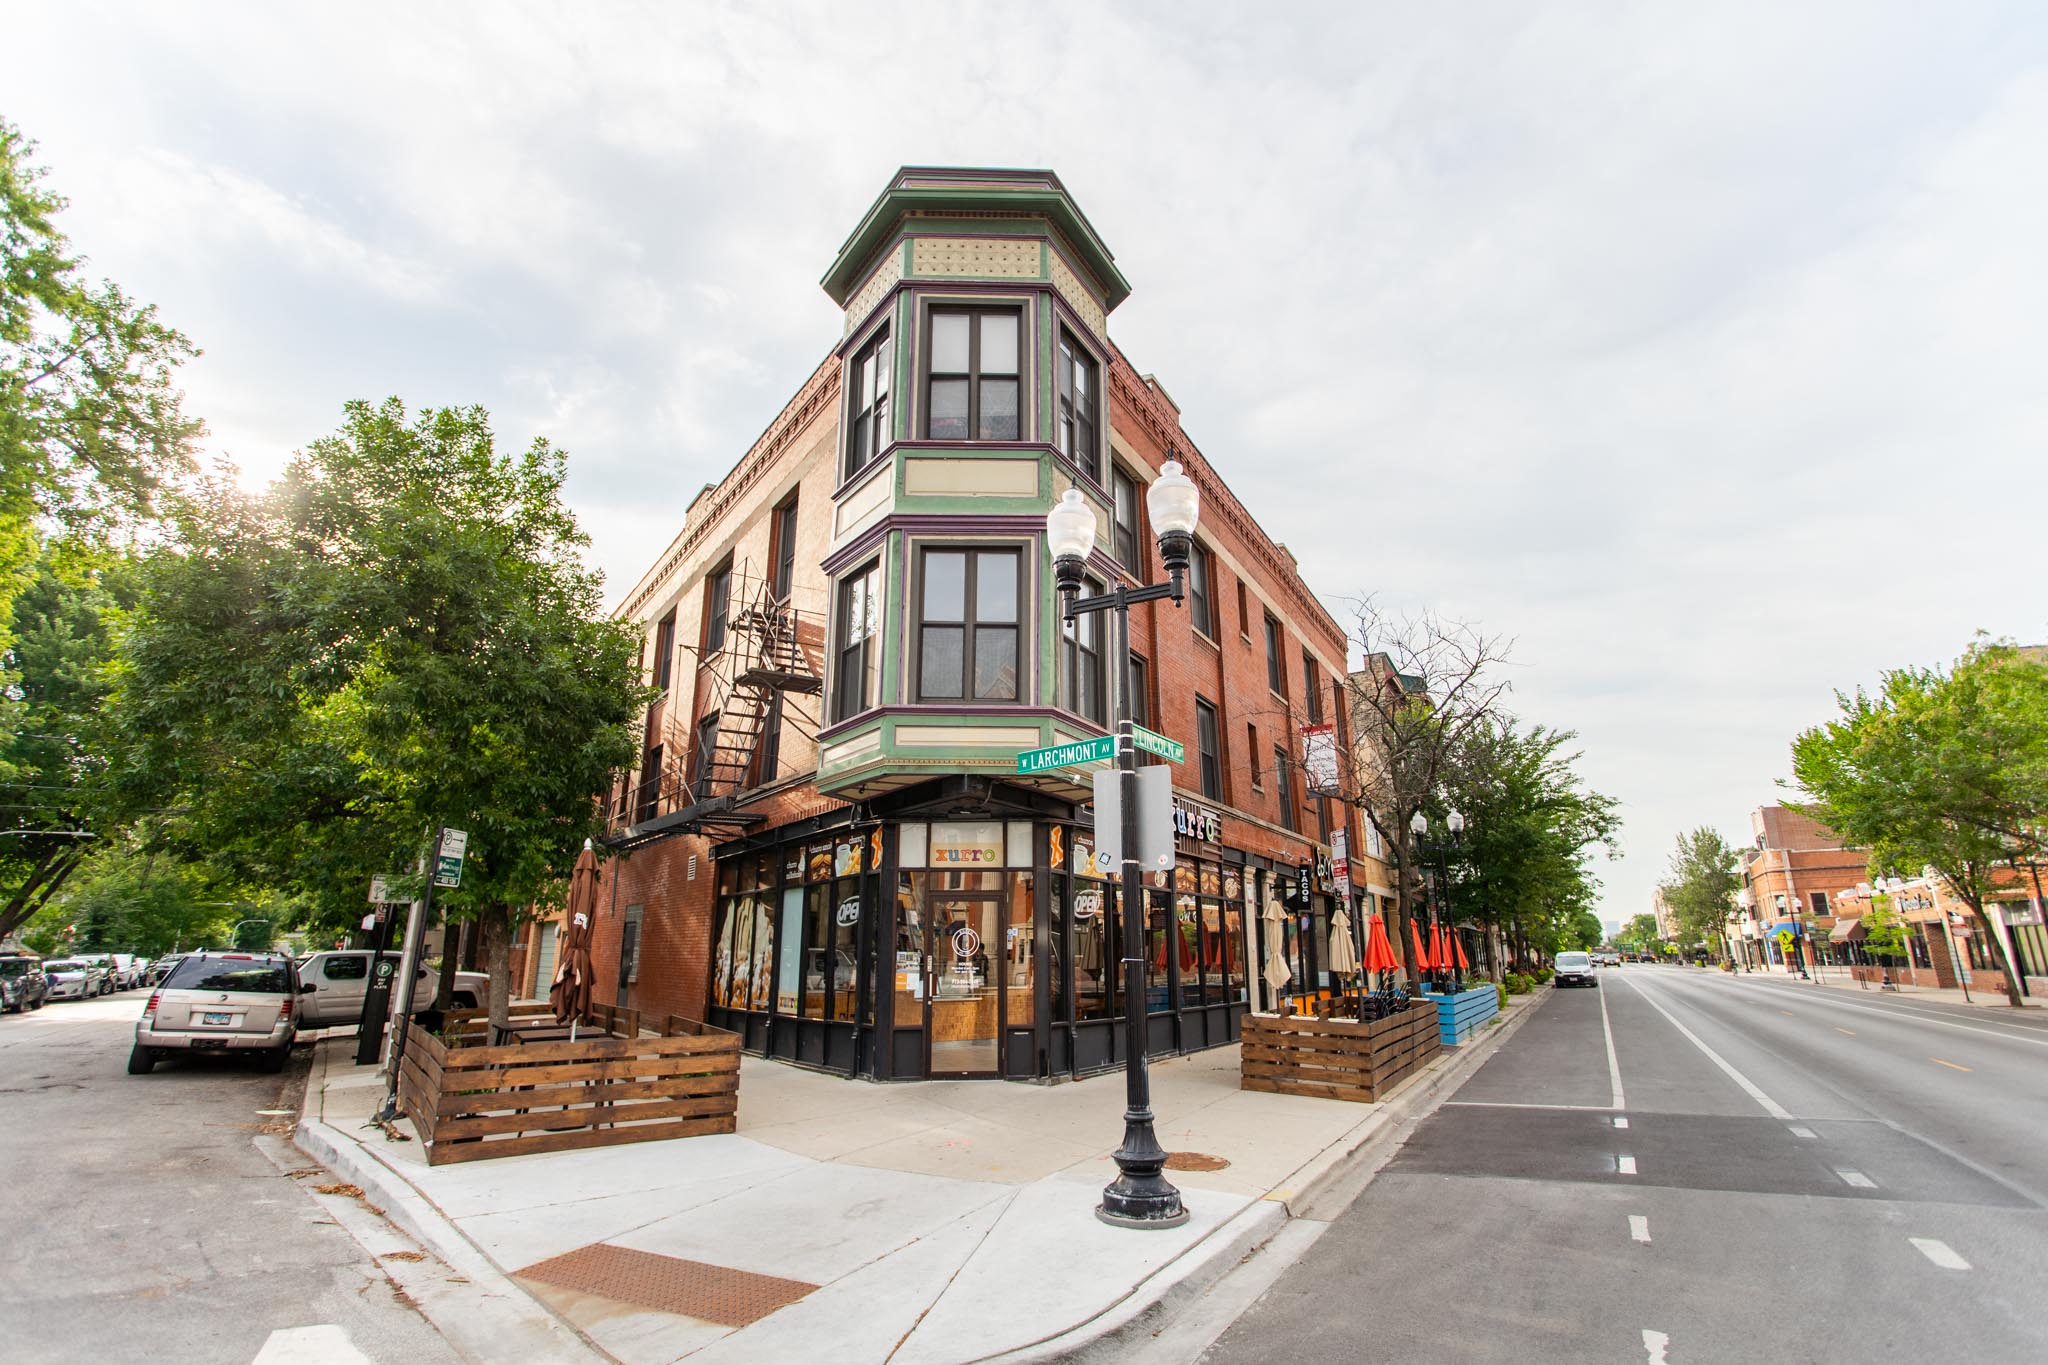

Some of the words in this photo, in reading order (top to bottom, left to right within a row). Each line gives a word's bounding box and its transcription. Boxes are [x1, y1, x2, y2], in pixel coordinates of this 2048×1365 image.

[1022, 759, 1027, 768] W
[1031, 742, 1097, 769] LARCHMONT
[1101, 743, 1110, 753] AV
[1139, 731, 1174, 758] LINCOLN
[935, 848, 996, 862] xurro
[1300, 869, 1309, 903] TACOS
[1075, 895, 1098, 913] OPEN
